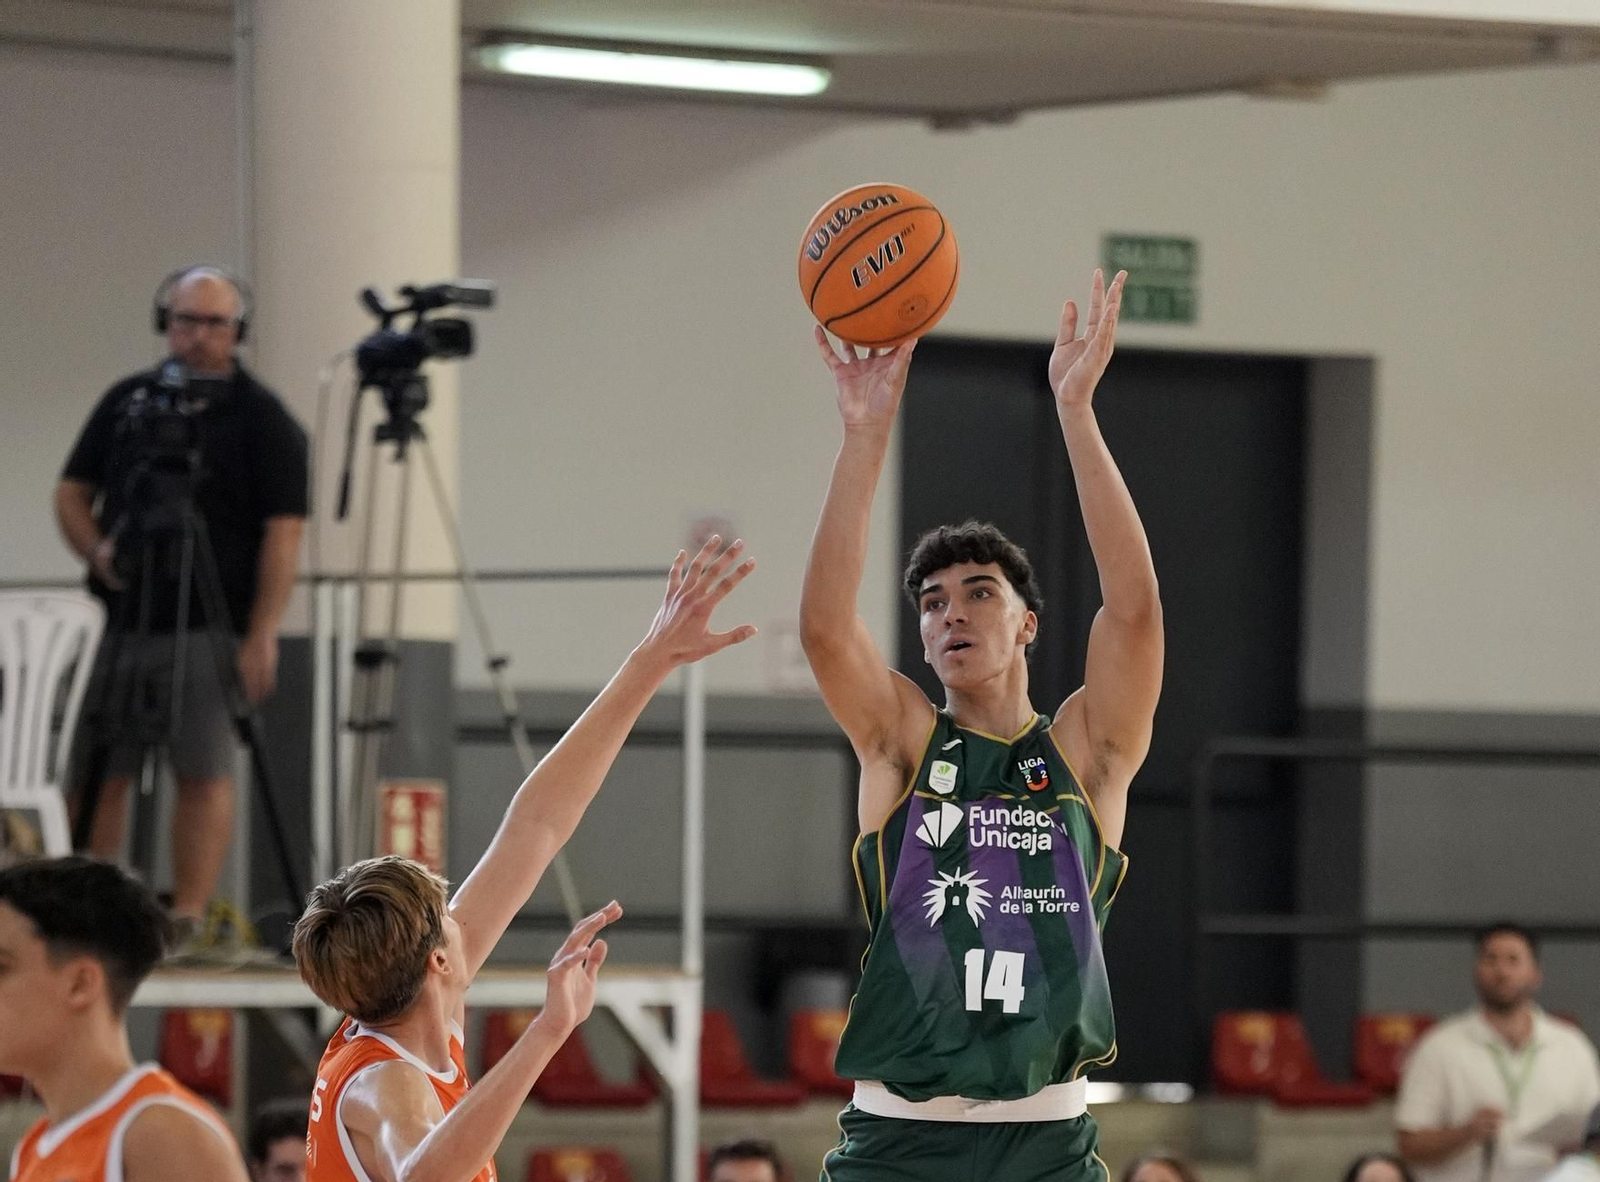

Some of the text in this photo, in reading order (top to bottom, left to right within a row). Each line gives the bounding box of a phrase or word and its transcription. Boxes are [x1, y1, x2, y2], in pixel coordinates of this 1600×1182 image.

[806, 193, 899, 262] Wilson
[851, 232, 905, 290] EVO
[1017, 756, 1046, 771] LIGA
[970, 826, 1052, 856] Unicaja
[1000, 900, 1080, 914] de la Torre
[964, 948, 1026, 1014] 14
